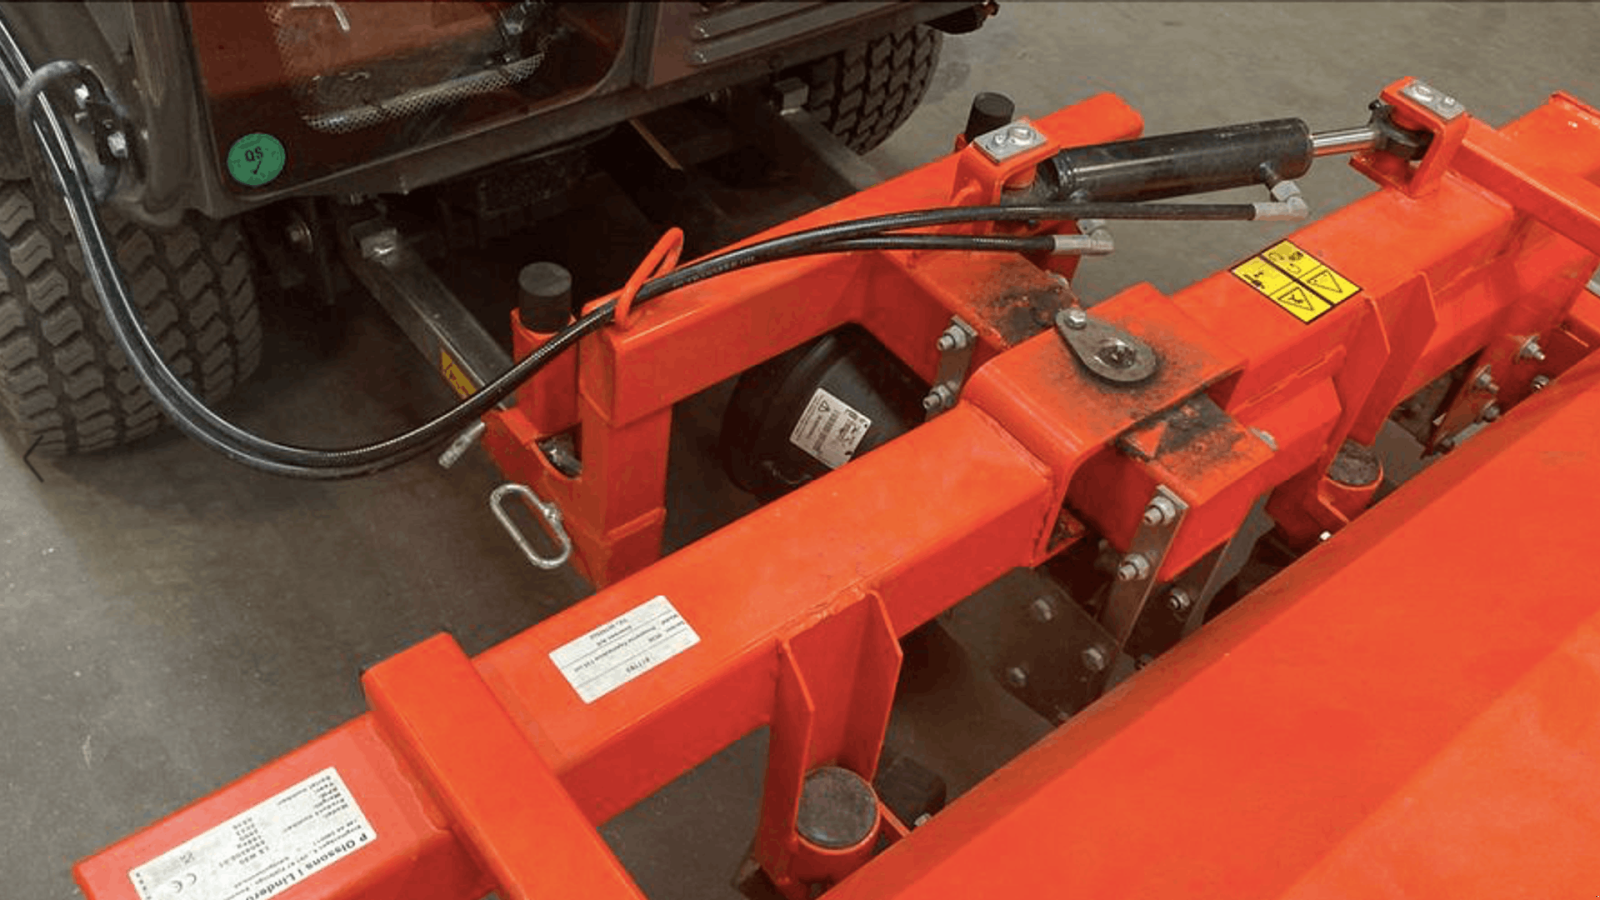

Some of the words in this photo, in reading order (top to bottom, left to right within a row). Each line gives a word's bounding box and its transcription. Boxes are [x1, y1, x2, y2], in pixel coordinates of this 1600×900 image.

[244, 145, 264, 163] QS
[359, 833, 368, 842] P
[305, 839, 356, 870] Olssons
